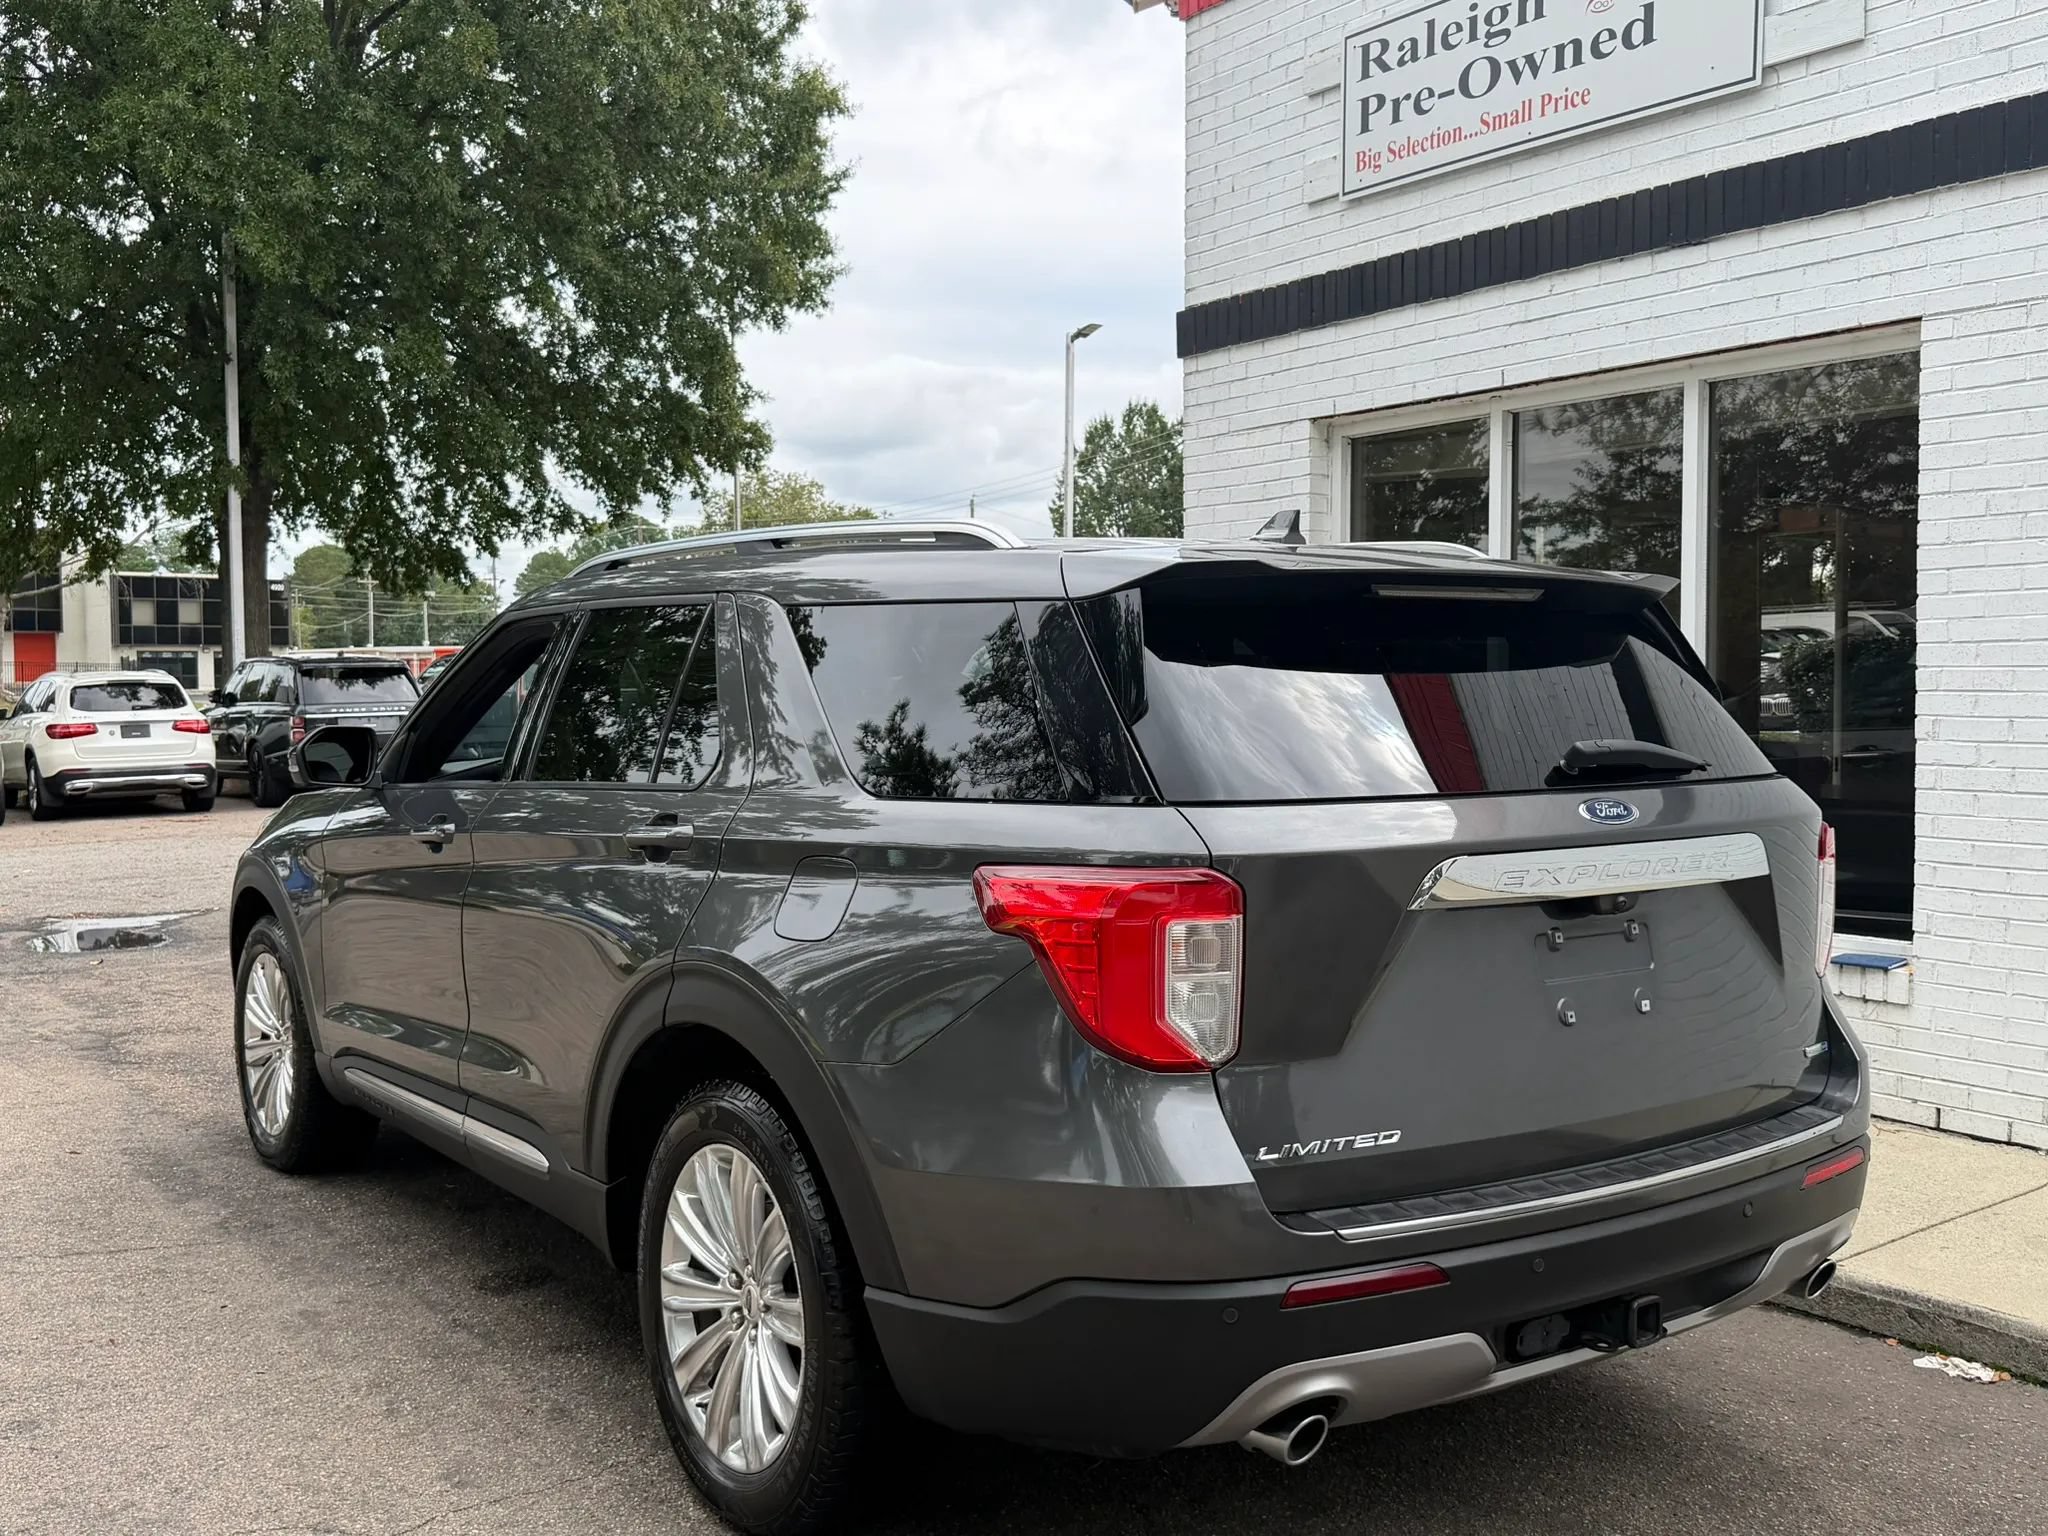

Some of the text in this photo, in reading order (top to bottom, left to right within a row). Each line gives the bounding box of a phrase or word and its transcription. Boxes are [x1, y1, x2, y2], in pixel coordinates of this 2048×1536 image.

[1356, 1, 1658, 136] Pre-Owned
[1356, 150, 1382, 173] Big
[1539, 87, 1591, 118] Price
[1594, 802, 1628, 817] Ford
[1494, 851, 1730, 889] EXPLORER
[1255, 1130, 1402, 1161] LIMITED
